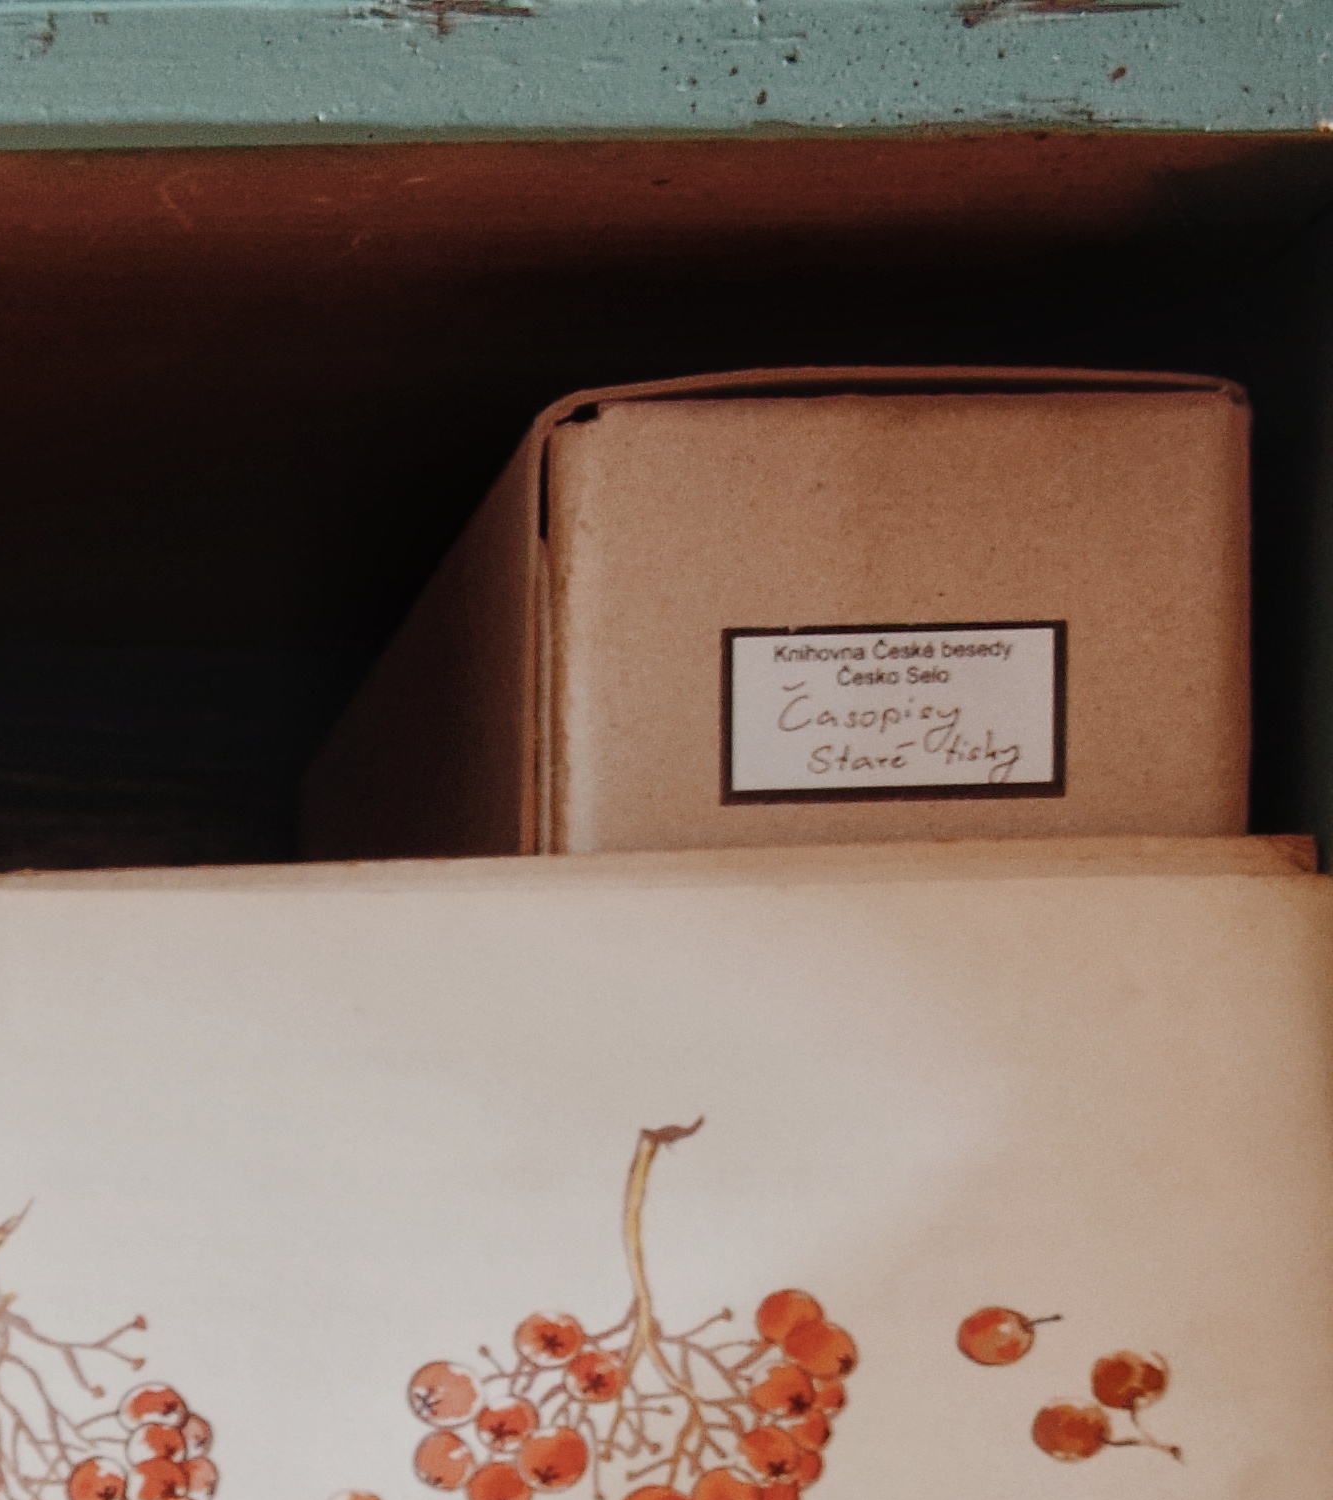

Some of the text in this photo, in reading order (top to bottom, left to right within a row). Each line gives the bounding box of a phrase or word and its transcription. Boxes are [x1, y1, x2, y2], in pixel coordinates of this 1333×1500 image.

[774, 640, 1013, 662] Knihovna České besedy
[837, 665, 951, 686] Česko Selo
